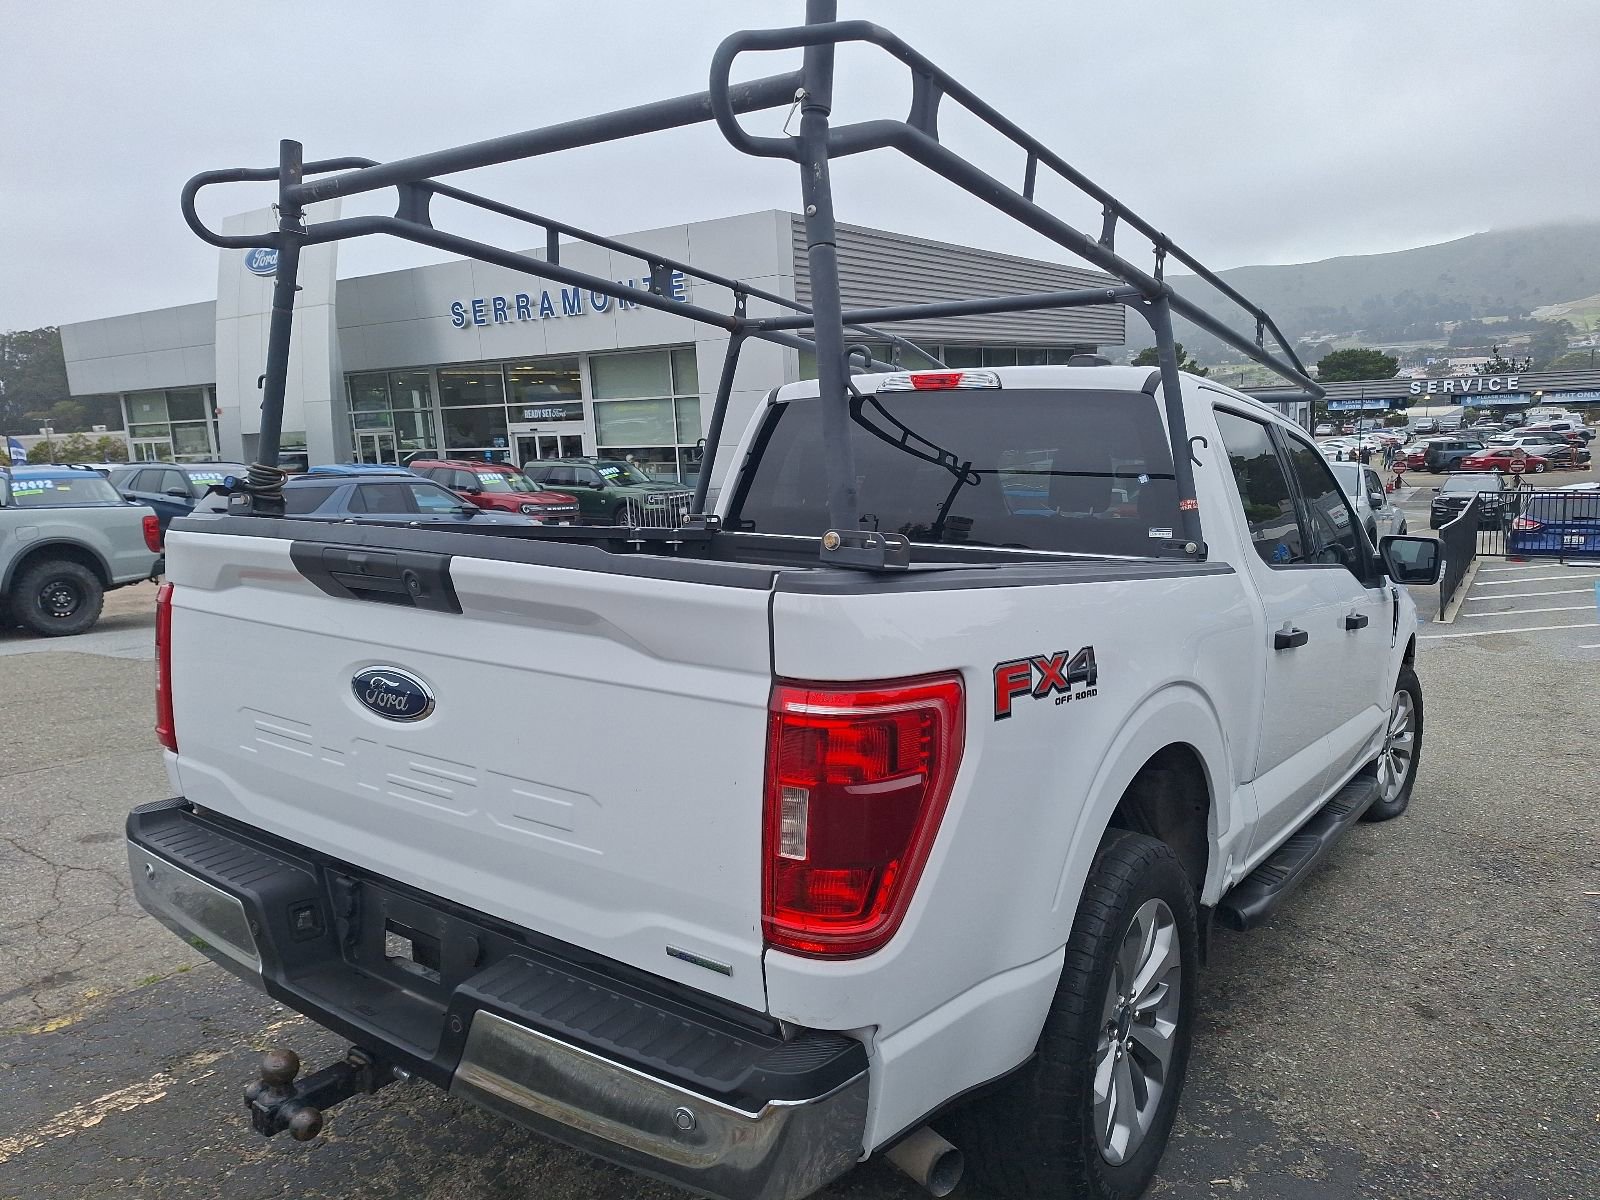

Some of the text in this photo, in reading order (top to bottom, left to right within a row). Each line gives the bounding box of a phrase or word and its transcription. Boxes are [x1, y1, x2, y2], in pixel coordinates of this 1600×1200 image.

[252, 248, 279, 268] Ford
[1409, 376, 1520, 395] SERVICE
[524, 409, 542, 419] READY
[542, 408, 552, 418] SET
[993, 645, 1097, 722] FX4
[1055, 688, 1098, 706] OFF ROAD
